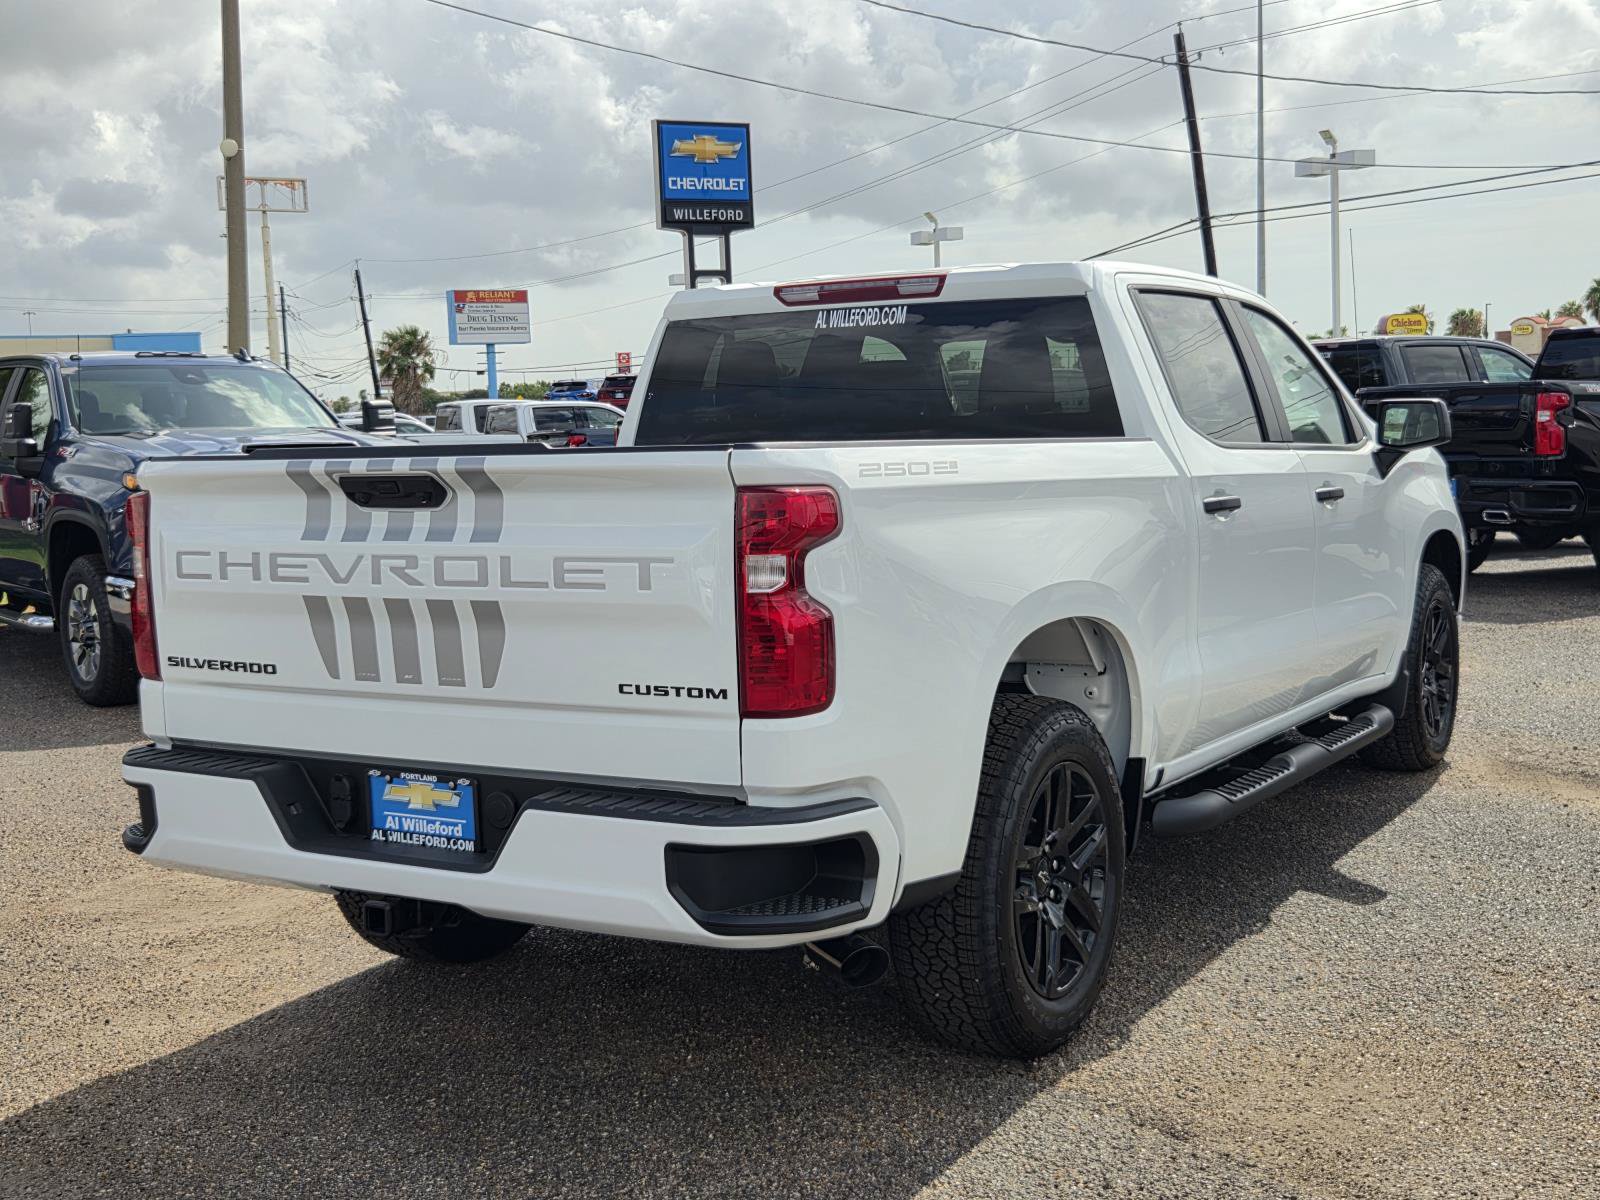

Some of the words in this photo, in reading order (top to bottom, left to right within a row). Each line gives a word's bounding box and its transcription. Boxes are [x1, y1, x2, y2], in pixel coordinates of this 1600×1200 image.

[668, 177, 745, 190] CHEVROLET
[673, 208, 744, 221] WILLEFORD
[467, 314, 487, 323] DRUG
[490, 314, 518, 322] TESTING
[815, 310, 827, 329] AL
[829, 305, 908, 329] WILLEFORD.COM
[175, 550, 675, 592] CHEVROLET
[167, 656, 278, 675] SILVERADO
[618, 683, 728, 700] CUSTOM
[400, 772, 438, 782] PORTLAND
[384, 815, 400, 830] Al
[402, 816, 463, 837] Willeford
[372, 829, 386, 841] AL
[388, 830, 475, 852] WILLEFORD.COM
